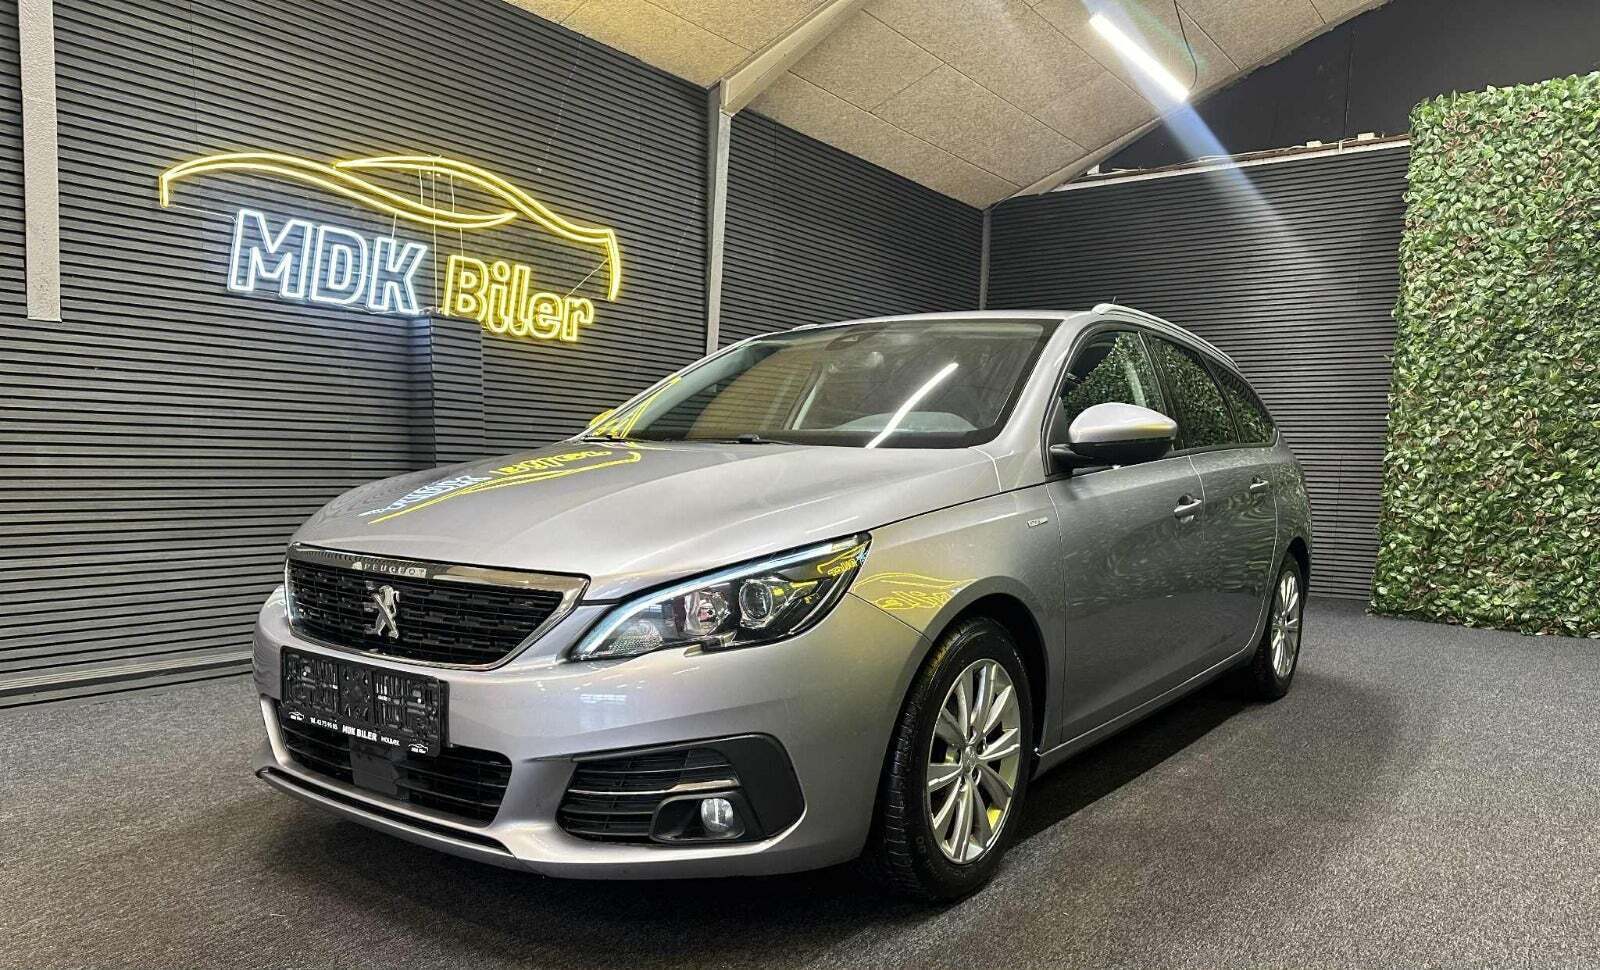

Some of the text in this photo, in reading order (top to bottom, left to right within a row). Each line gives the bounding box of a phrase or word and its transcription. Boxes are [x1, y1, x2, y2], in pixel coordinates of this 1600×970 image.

[227, 208, 595, 342] MDK Biler
[364, 562, 427, 579] PEUGEOT
[342, 724, 356, 736] MDK
[356, 728, 378, 742] BILER
